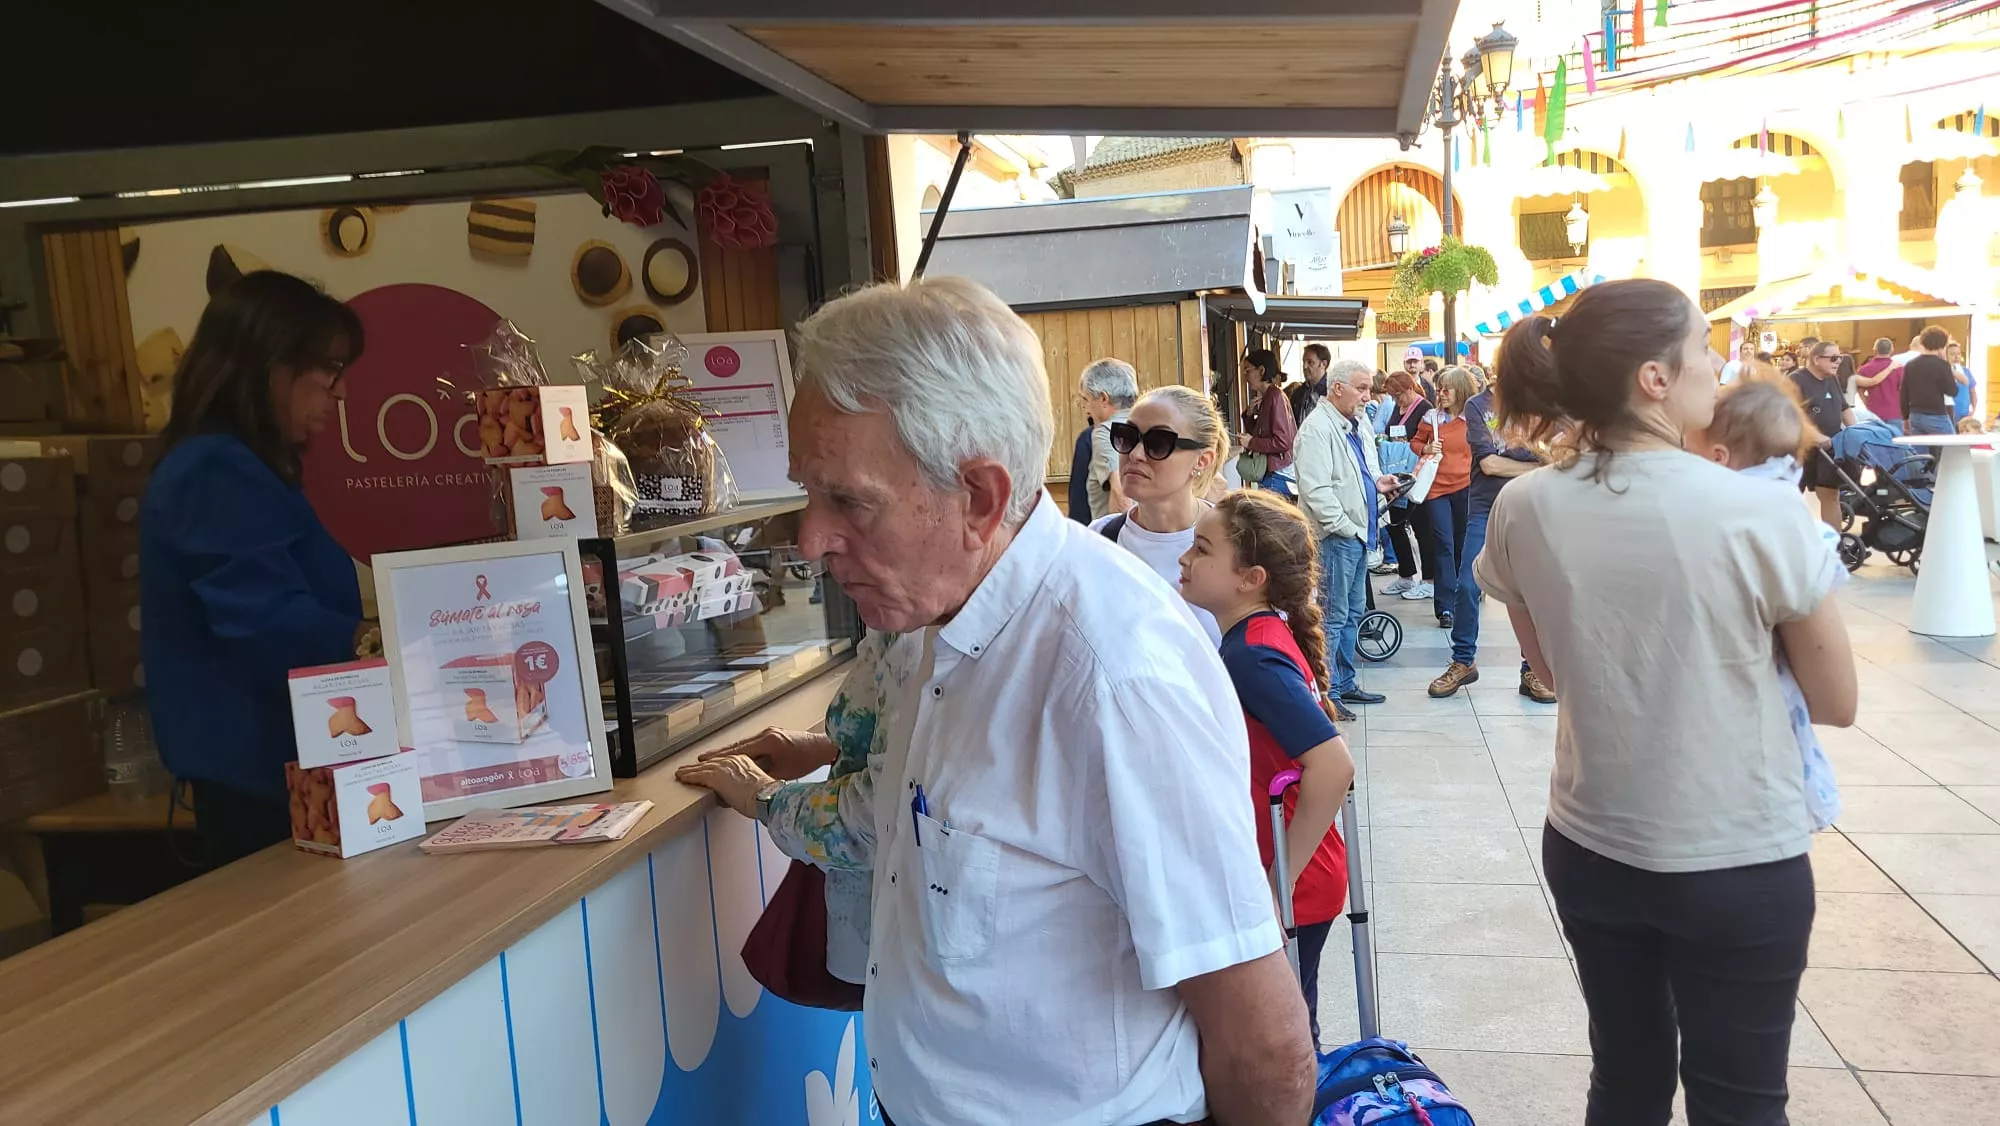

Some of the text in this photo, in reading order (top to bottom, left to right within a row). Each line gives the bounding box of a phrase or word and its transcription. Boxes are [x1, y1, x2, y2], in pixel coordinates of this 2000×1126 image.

[346, 472, 495, 489] PASTELERÍA CREATIV
[488, 603, 504, 619] al
[506, 601, 541, 619] rosa
[524, 654, 548, 671] 1€
[460, 771, 504, 786] altoaragón
